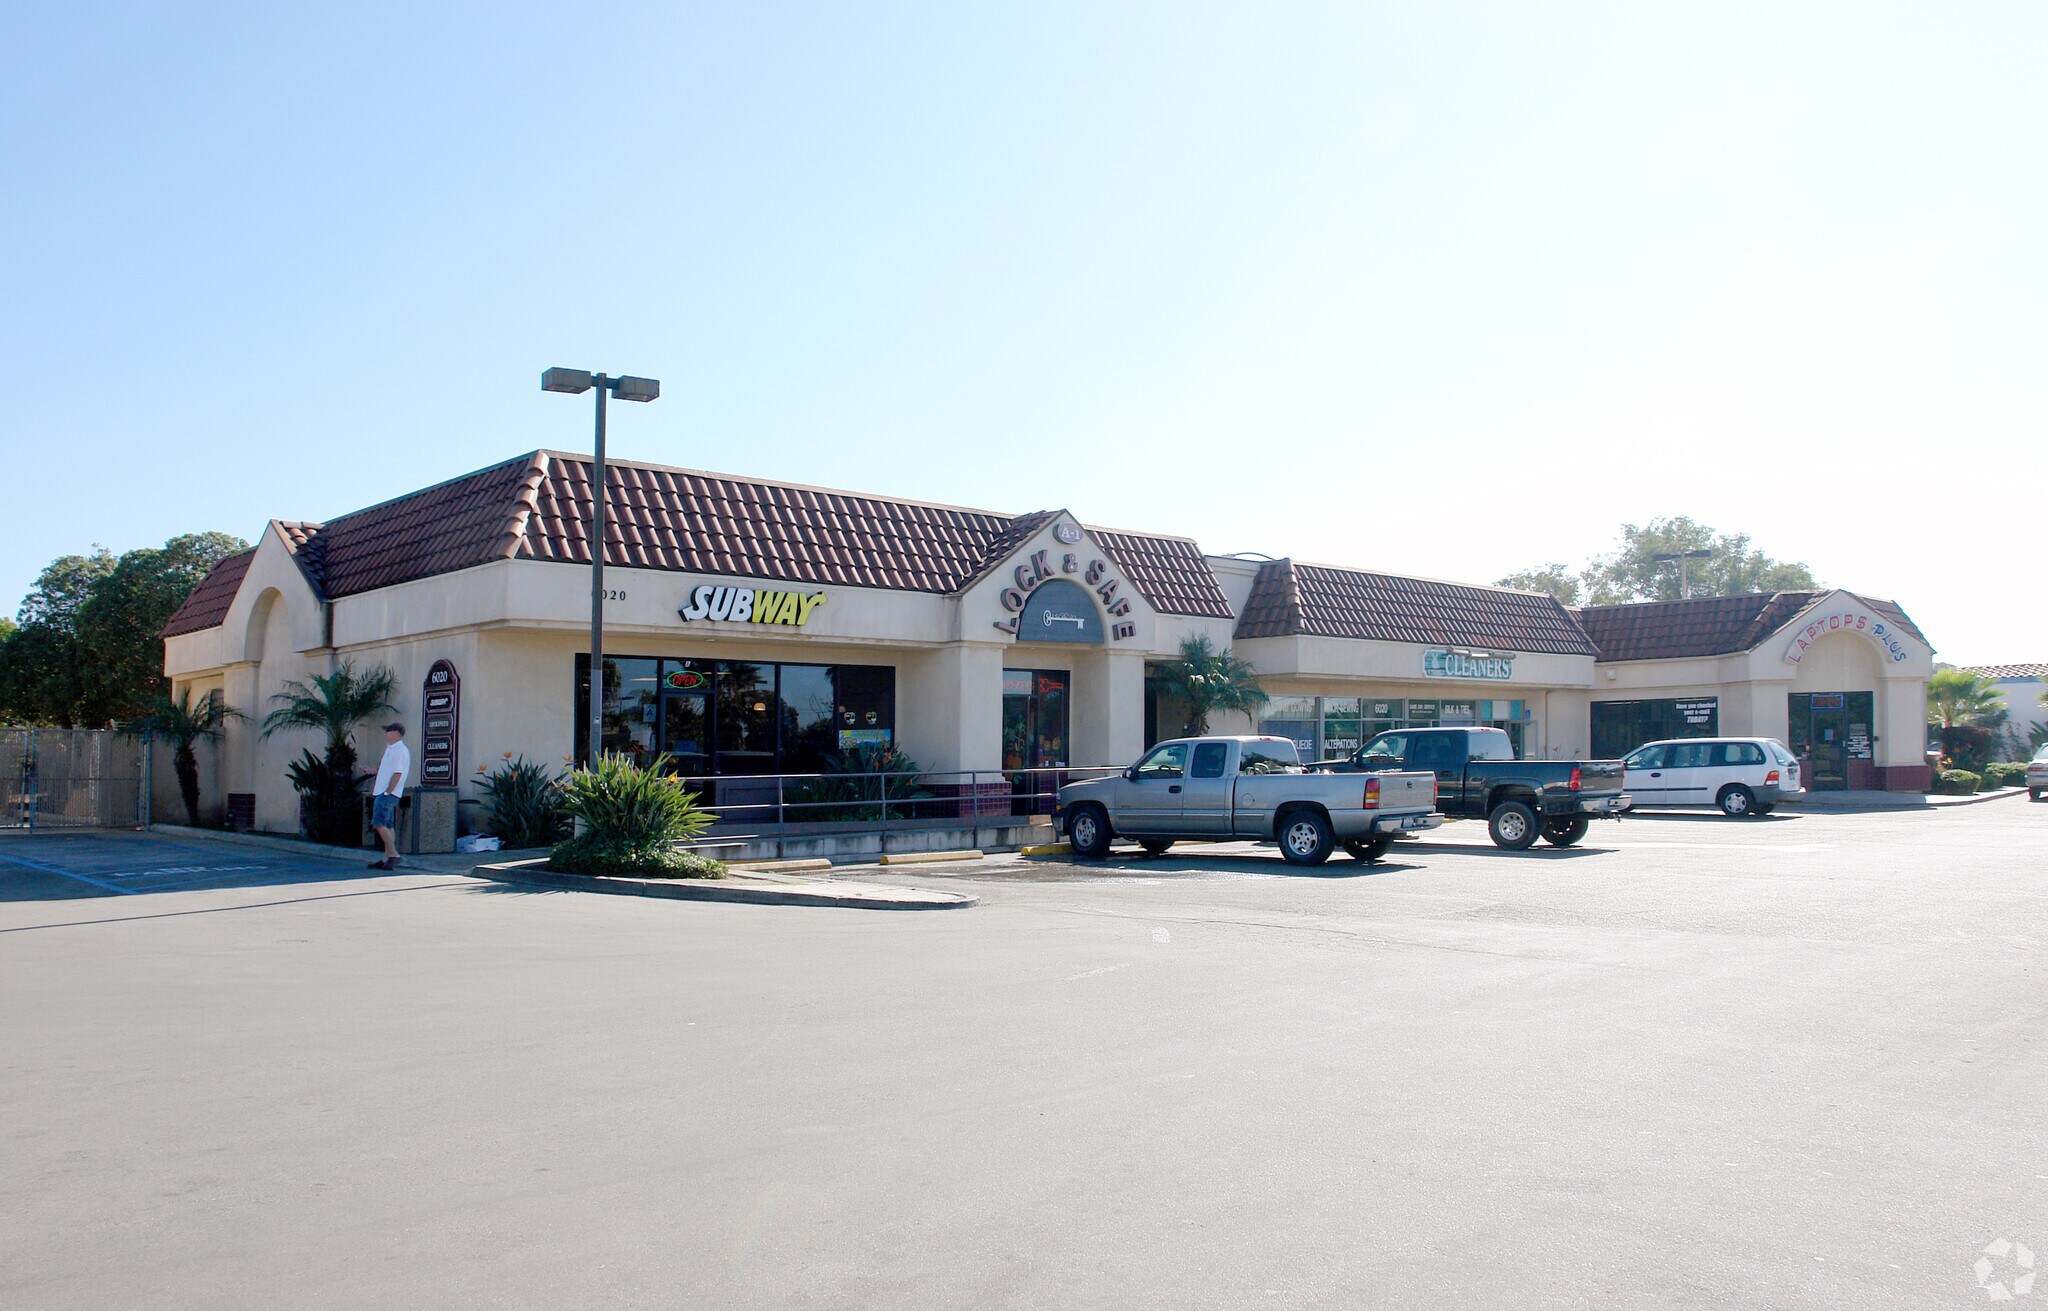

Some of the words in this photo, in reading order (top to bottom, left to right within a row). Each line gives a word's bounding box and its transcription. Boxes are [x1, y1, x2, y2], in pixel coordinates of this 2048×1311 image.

[1061, 525, 1081, 540] A-1
[592, 590, 626, 601] 020
[993, 549, 1055, 634] LOCK
[1062, 553, 1078, 573] &
[1085, 559, 1136, 641] SAFE
[678, 585, 828, 625] SUBWAY
[1789, 613, 1867, 664] LAPTOPS
[1872, 623, 1908, 664] PLUS
[1445, 654, 1510, 678] CLEANERS
[431, 671, 448, 683] 6020
[672, 674, 698, 687] OPEN
[1374, 703, 1388, 714] 6020
[1444, 704, 1454, 714] SILK
[1460, 704, 1470, 714] TIES
[1687, 715, 1708, 723] TODAY?
[427, 742, 448, 750] CLEANERS
[1293, 739, 1313, 750] SUEDE
[1324, 738, 1358, 749] ALTERATIONS
